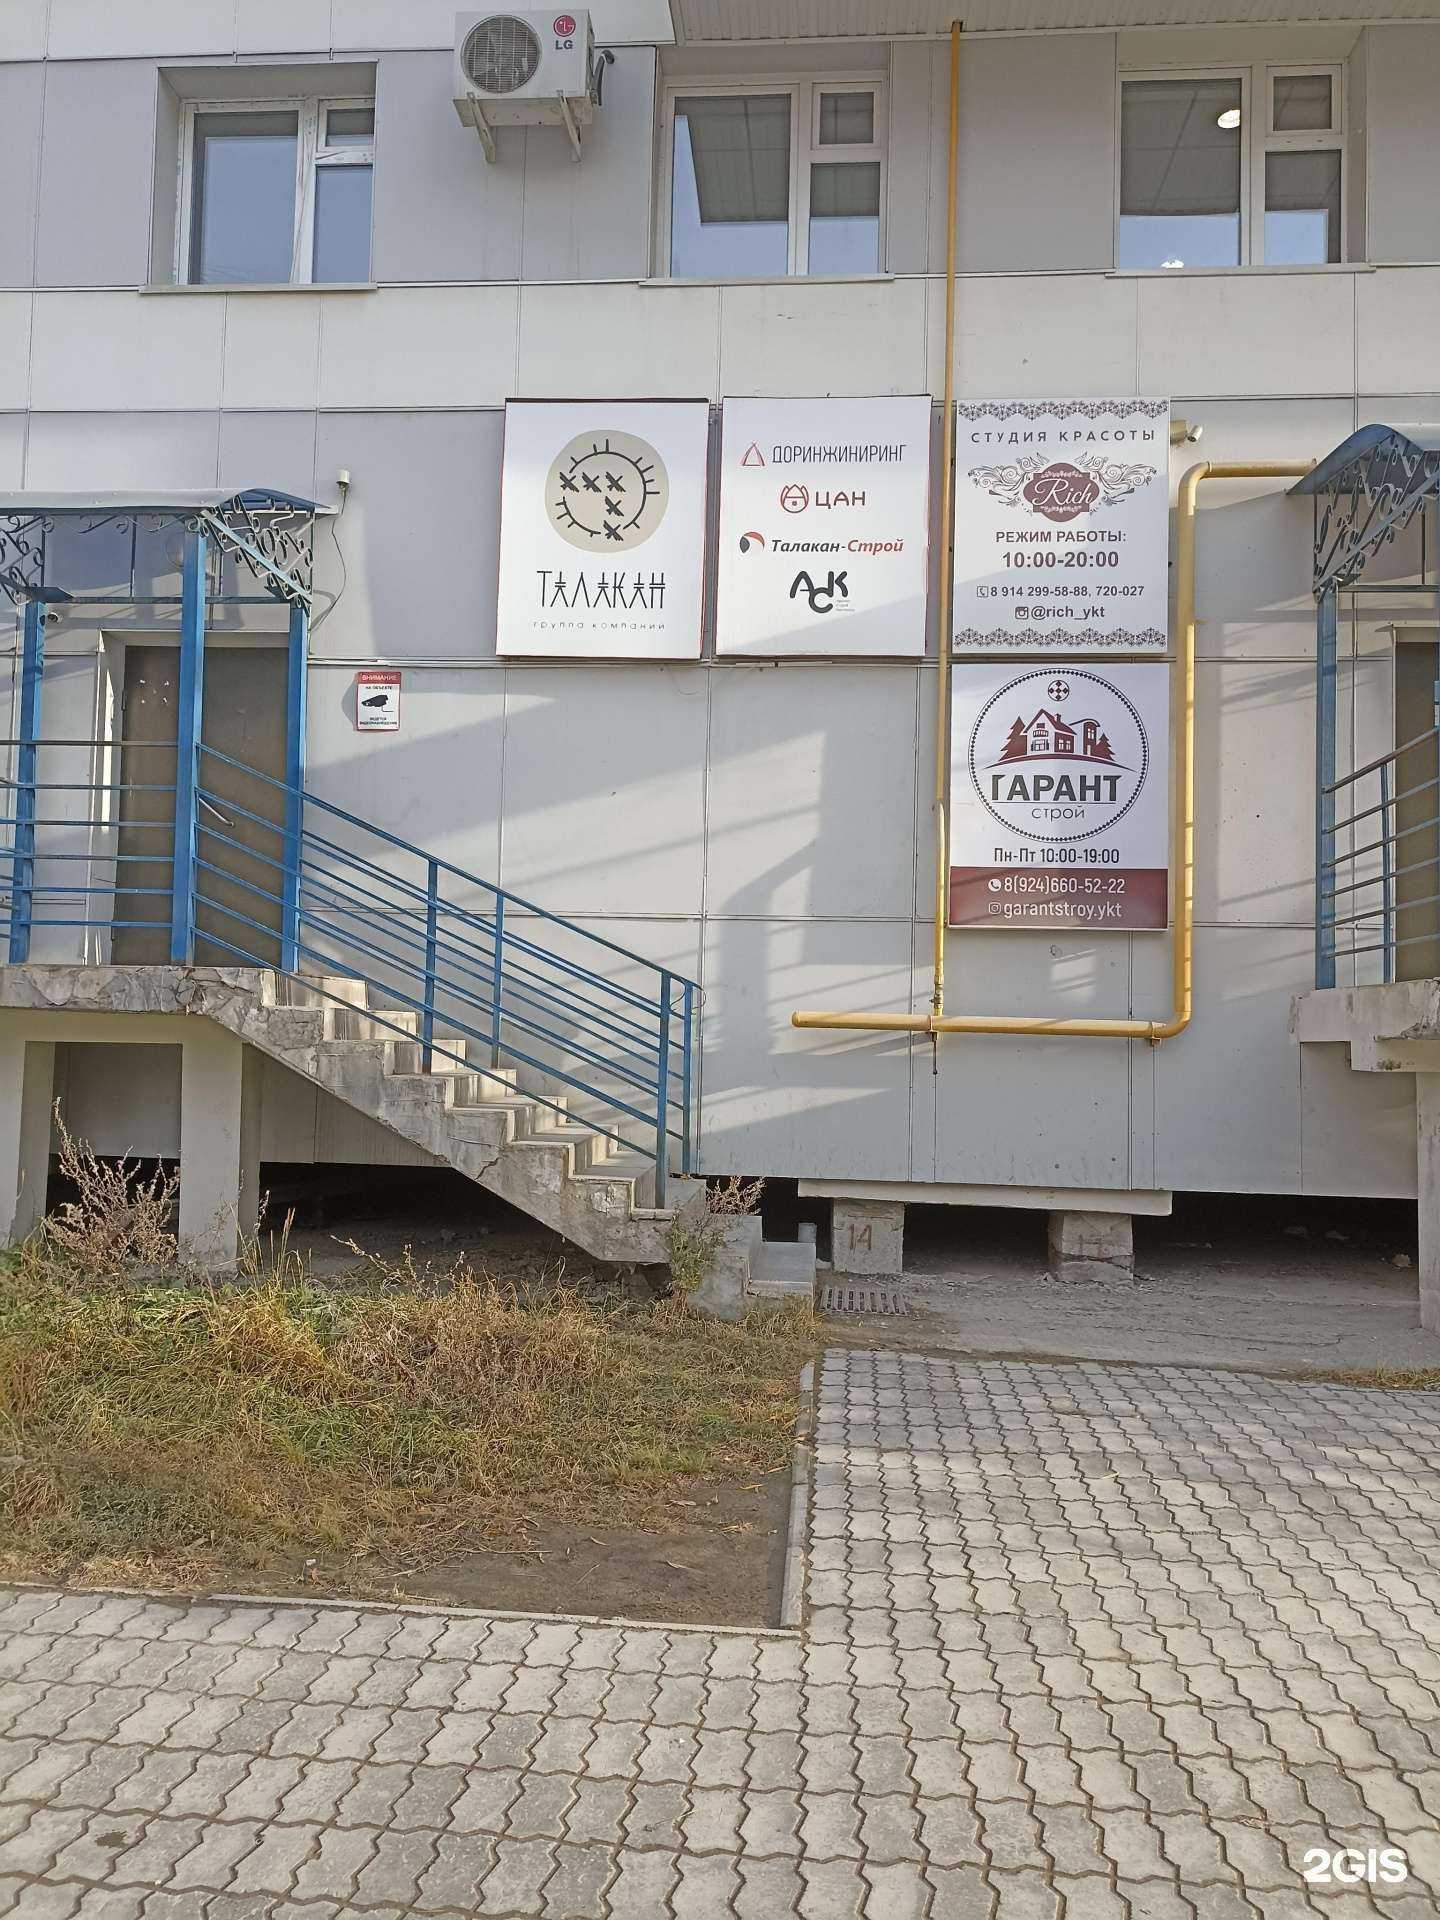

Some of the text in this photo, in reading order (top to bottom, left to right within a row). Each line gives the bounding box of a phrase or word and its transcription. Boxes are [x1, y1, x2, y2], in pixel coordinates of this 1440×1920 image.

[555, 39, 573, 50] LG
[971, 430, 1155, 445] СТУДИЯ КРАСОТЫ
[771, 444, 907, 464] ДОРИНЖИНИРИНГ
[815, 491, 866, 509] ЦАН
[1032, 478, 1093, 505] Rich
[995, 530, 1127, 543] РЕЖИМ РАБОТЫ:
[771, 538, 904, 556] Талакан-Строй
[1002, 551, 1119, 568] 10:00-20:00
[536, 570, 666, 609] ТАЛАКАН
[990, 585, 1145, 598] 8 914 299-58-88, 720-027
[1030, 605, 1105, 620] @rich_ykt
[532, 621, 666, 631] группа компании
[991, 774, 1123, 802] ГАРАНТ
[1031, 805, 1085, 822] строй
[994, 847, 1120, 864] Пн-Пт 10:00-19:00
[1004, 875, 1125, 895] 8(924)660-52-22
